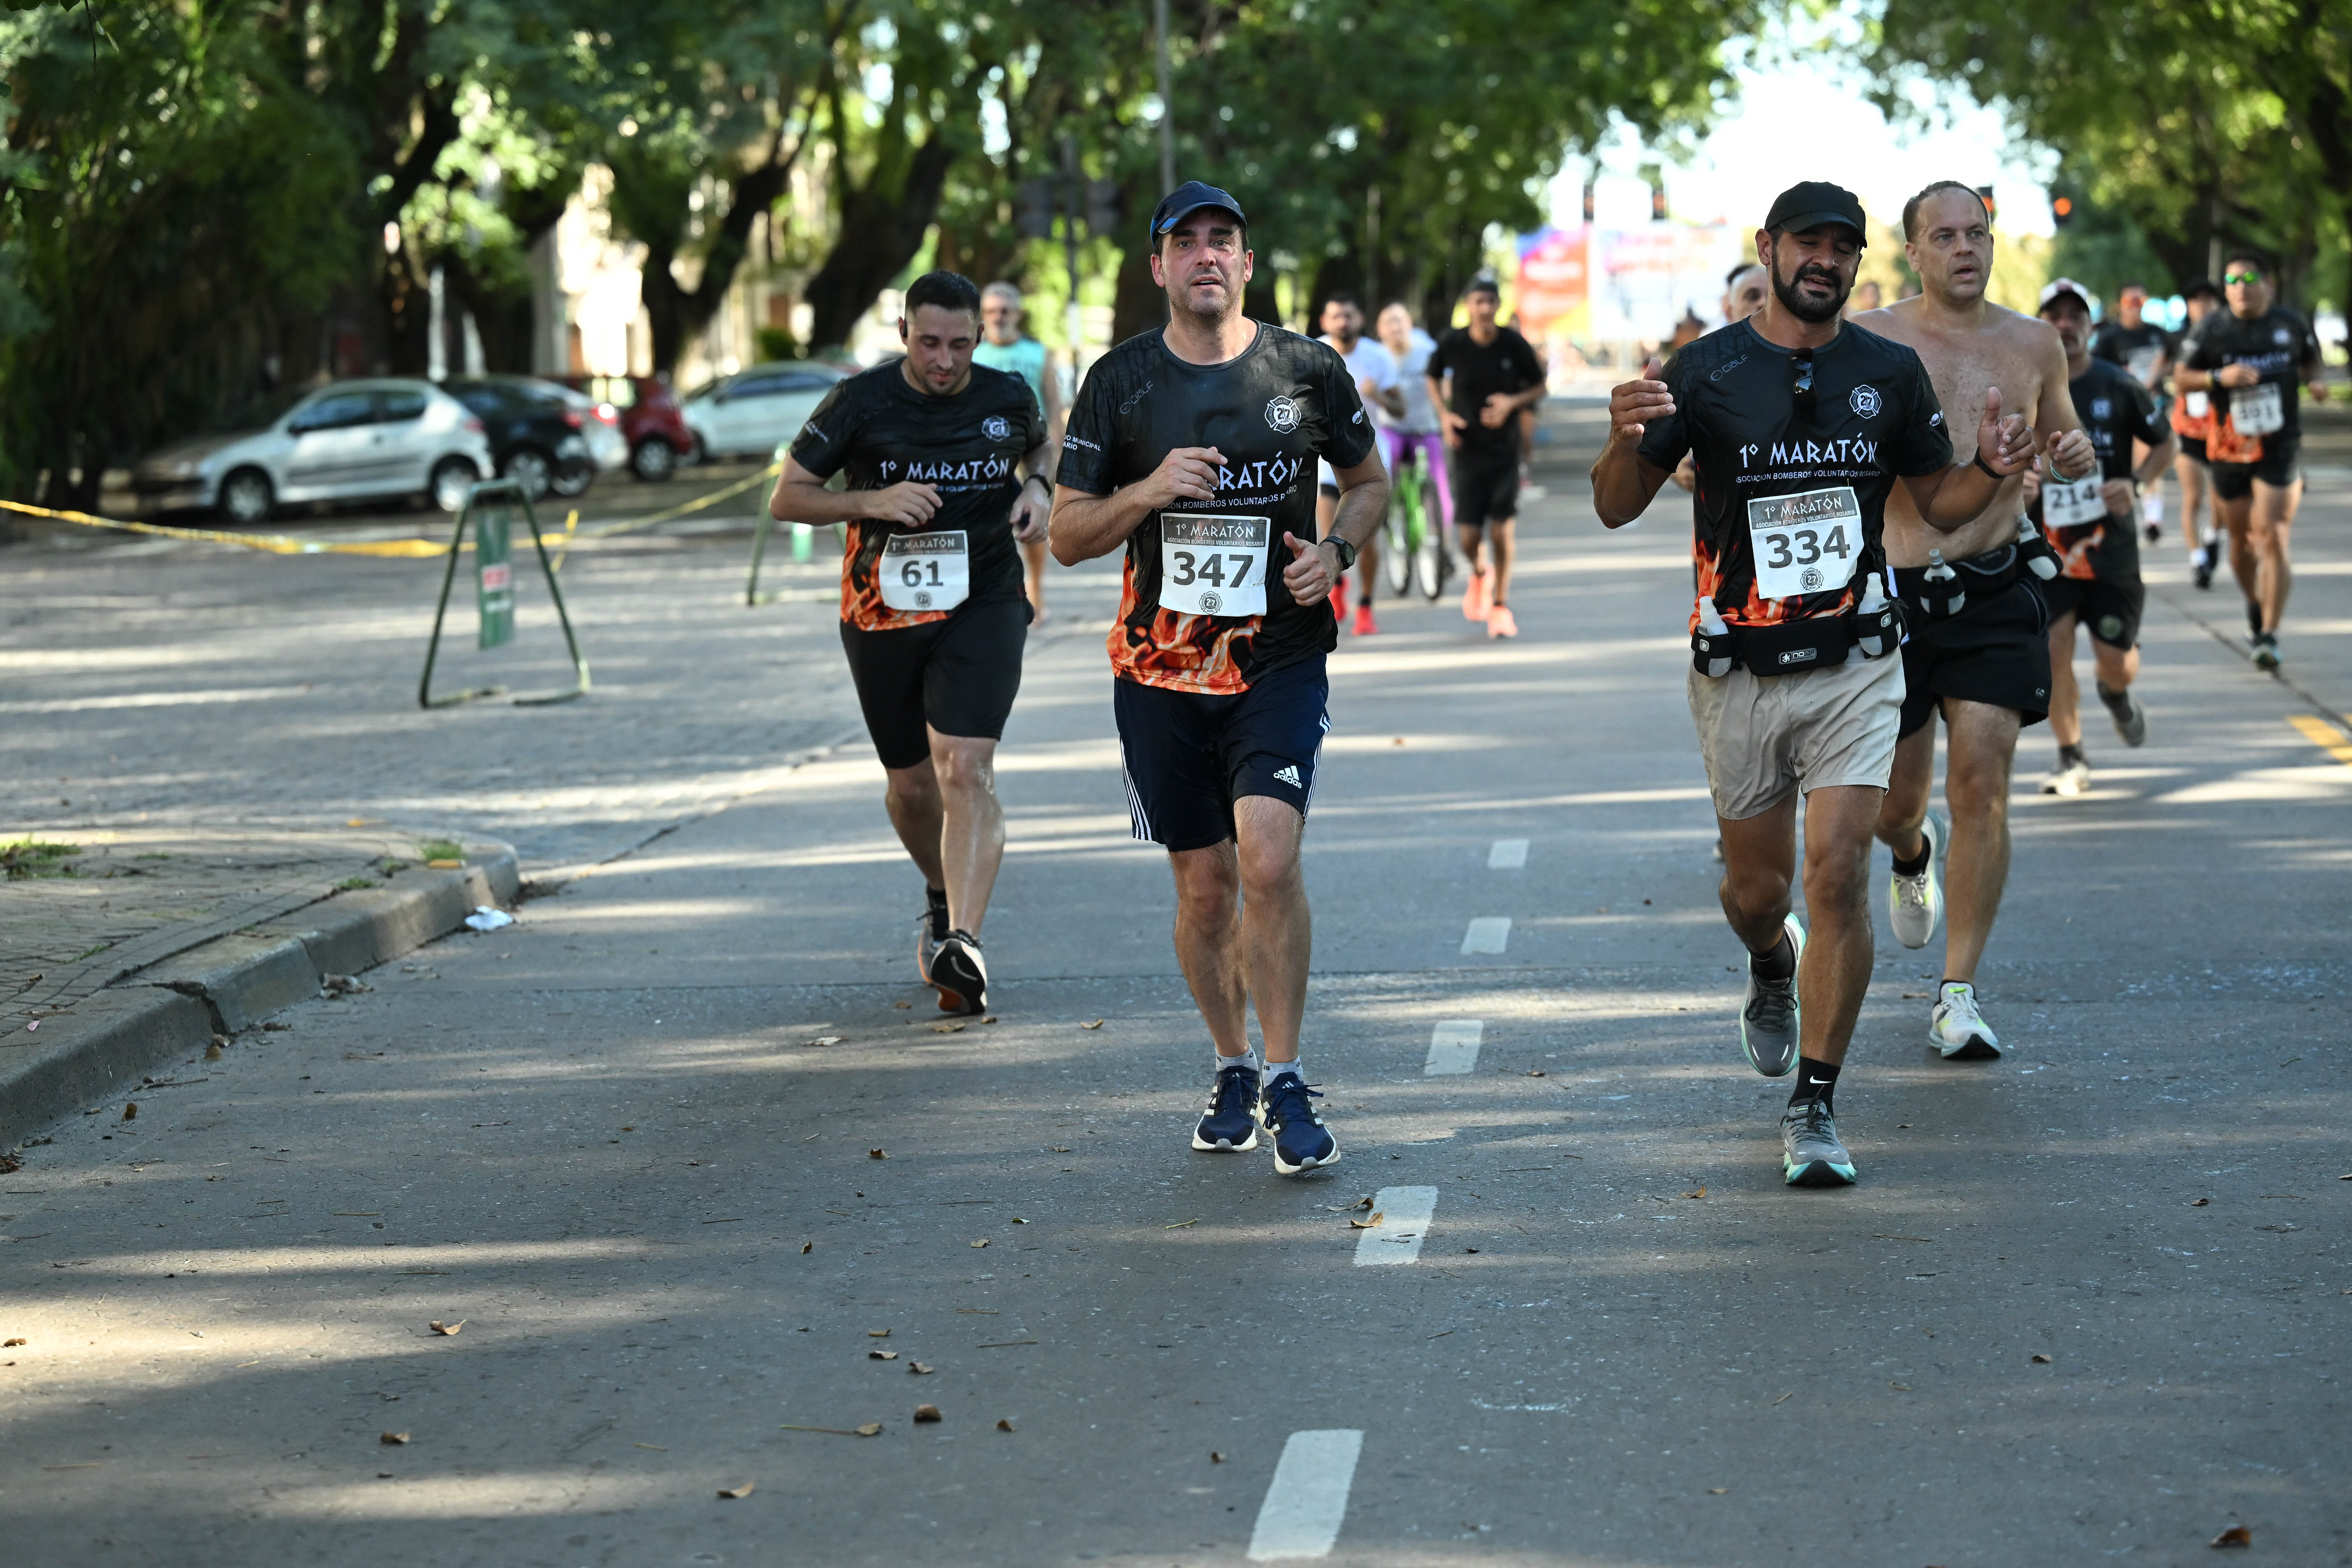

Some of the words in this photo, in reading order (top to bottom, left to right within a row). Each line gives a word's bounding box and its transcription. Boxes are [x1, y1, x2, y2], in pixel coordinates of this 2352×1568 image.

[1072, 437, 1101, 451] MUNICIPAL
[1769, 432, 1878, 466] MARATÓN
[906, 453, 1009, 480] MARATÓN
[1208, 450, 1303, 491] RATÓN
[1773, 471, 1812, 480] BOMBEROS
[1814, 470, 1858, 478] VOLUNTARIOS
[1183, 499, 1227, 509] BOMBEROS
[1228, 494, 1278, 507] VOLUNTARIOS
[1780, 494, 1842, 518] MARATÓN
[2050, 485, 2096, 508] 214
[1783, 517, 1806, 525] BOMBEROS
[1806, 512, 1836, 522] VOLUNTARIOS
[1190, 522, 1253, 538] MARATÓN
[1766, 525, 1851, 569] 334
[901, 559, 943, 587] 61
[1173, 551, 1253, 588] 347
[1807, 575, 1816, 584] 27
[1206, 598, 1216, 607] 27
[1273, 772, 1302, 789] adidas
